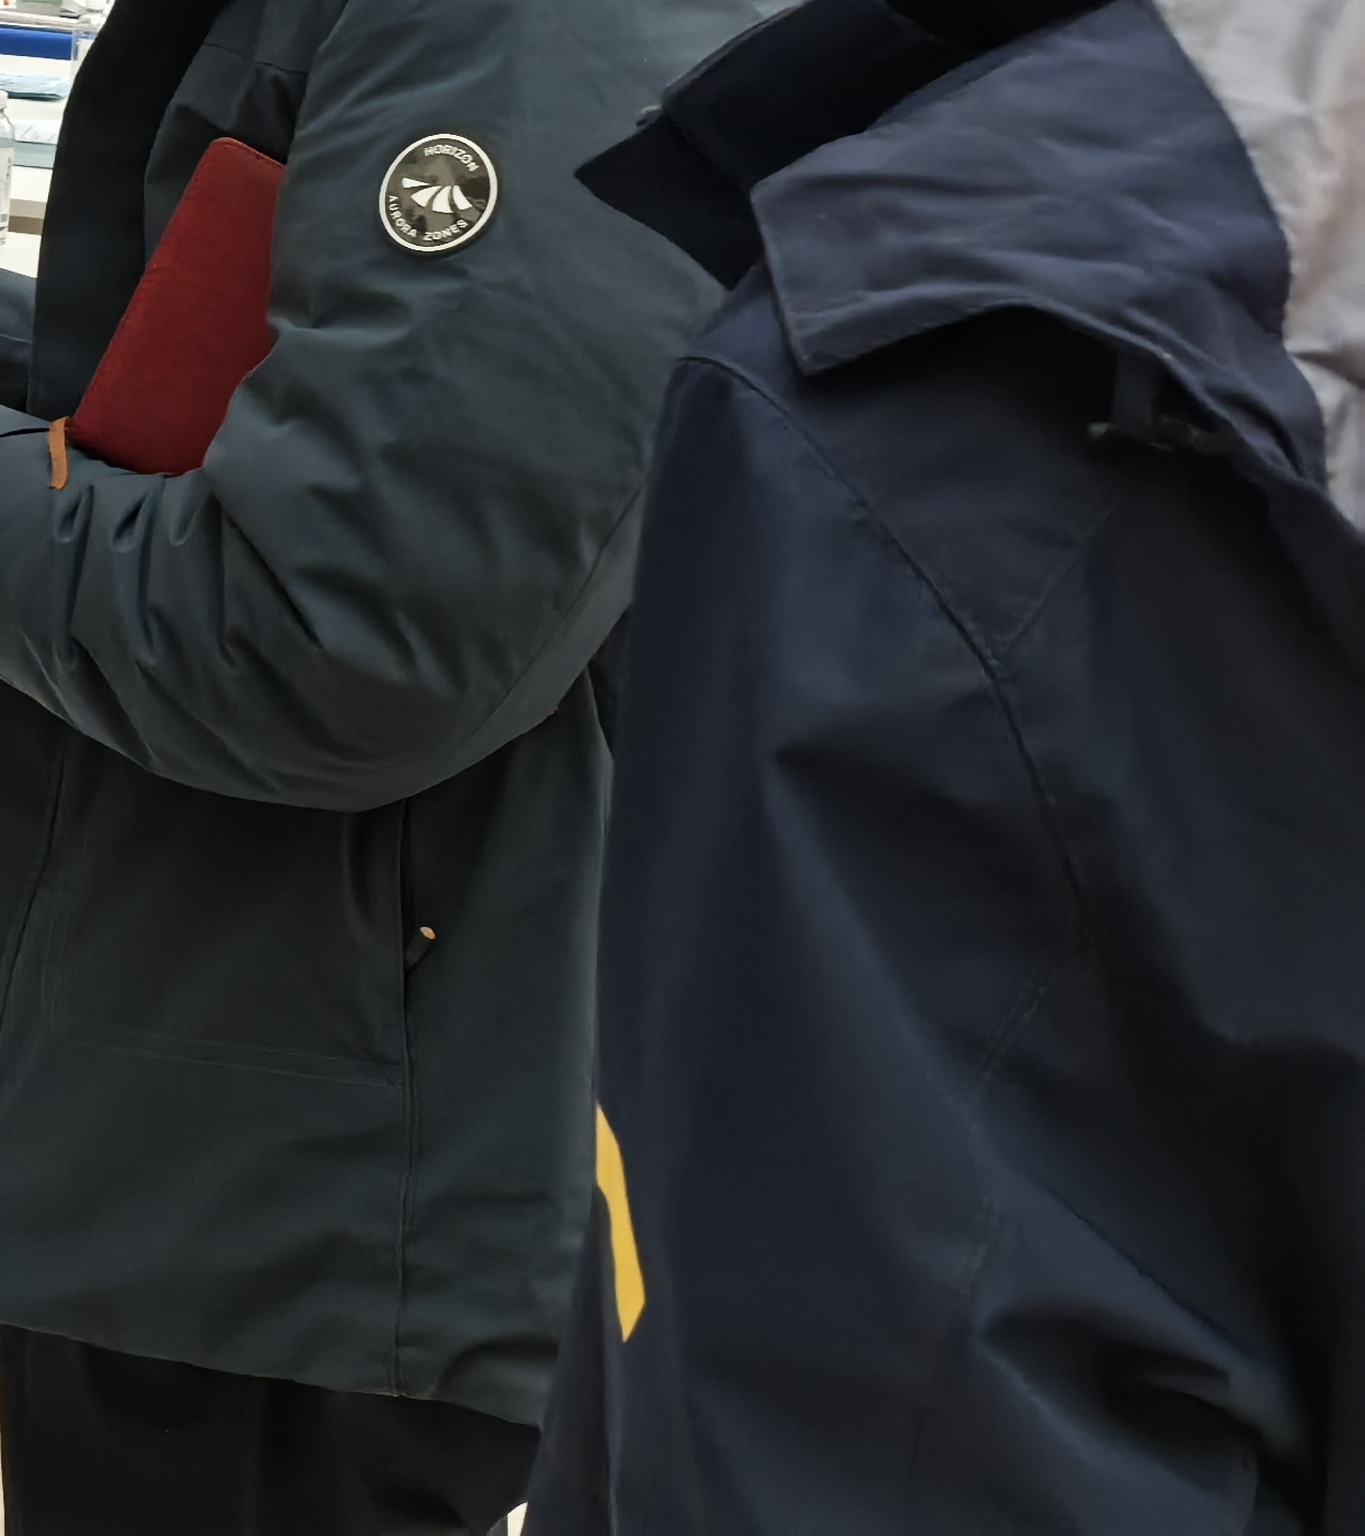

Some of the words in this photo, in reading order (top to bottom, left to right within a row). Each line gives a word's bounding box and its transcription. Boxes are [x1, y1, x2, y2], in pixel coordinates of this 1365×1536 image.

[424, 144, 480, 172] HORIZON
[388, 195, 418, 238] AURORA
[422, 219, 469, 242] ZONES
